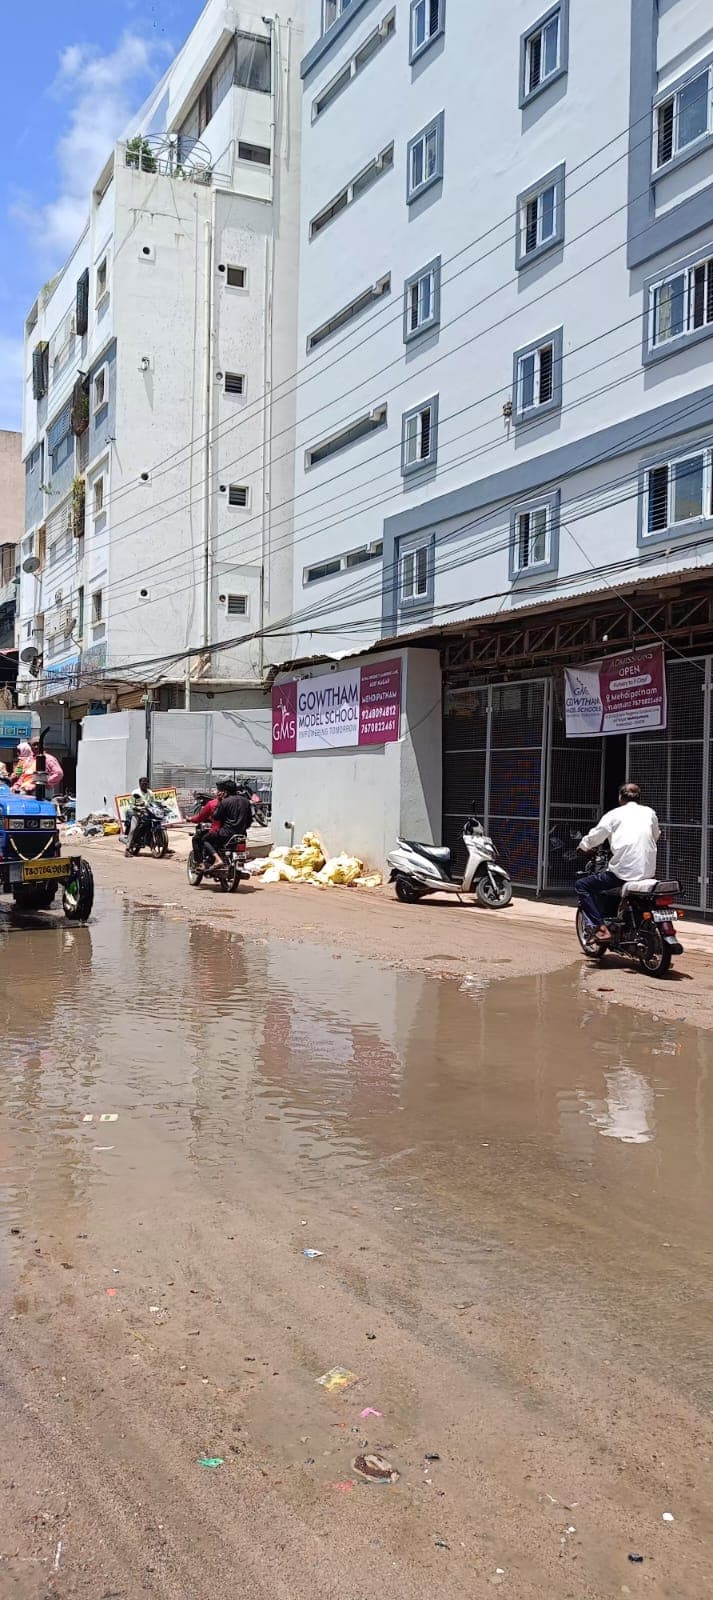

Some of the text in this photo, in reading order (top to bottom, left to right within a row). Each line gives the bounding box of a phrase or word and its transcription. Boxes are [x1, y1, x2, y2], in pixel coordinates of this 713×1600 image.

[619, 665, 641, 676] OPEN
[299, 684, 359, 711] GOWTHAM
[299, 707, 358, 729] MODEL SCHOOL
[273, 720, 296, 741] GMS
